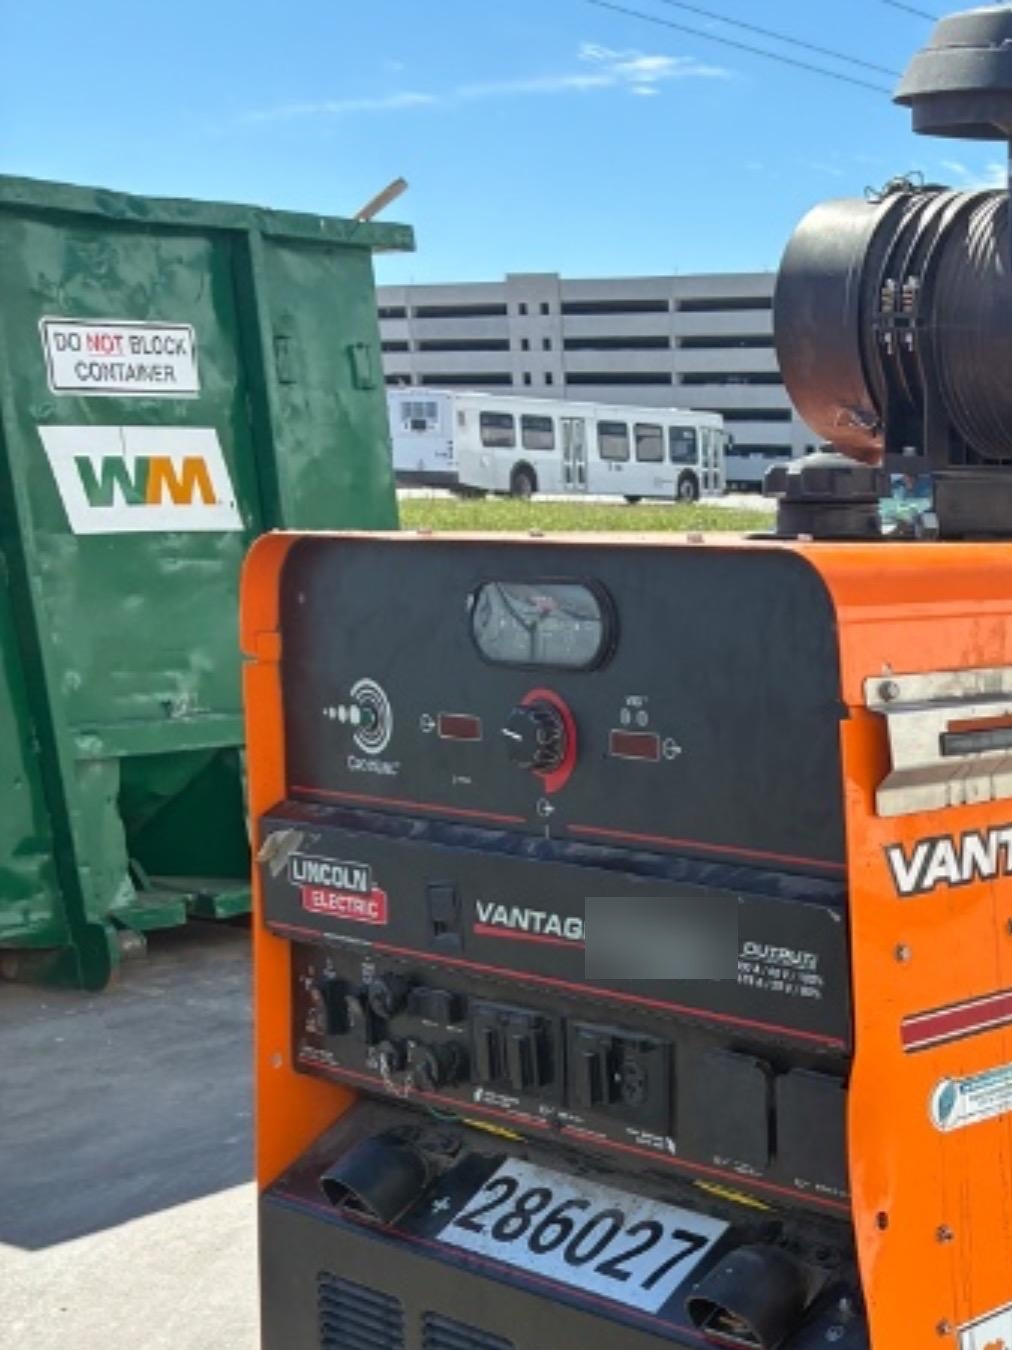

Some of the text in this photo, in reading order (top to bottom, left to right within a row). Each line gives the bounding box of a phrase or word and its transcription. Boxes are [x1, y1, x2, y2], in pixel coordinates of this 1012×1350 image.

[53, 332, 187, 356] DO NOT BLOCK
[74, 360, 177, 383] CONTAINER
[74, 454, 217, 508] WM
[293, 856, 367, 892] LINCOLN
[312, 889, 379, 919] ELECTRIC
[475, 899, 586, 940] VANTAG
[452, 1175, 710, 1291] 286027
